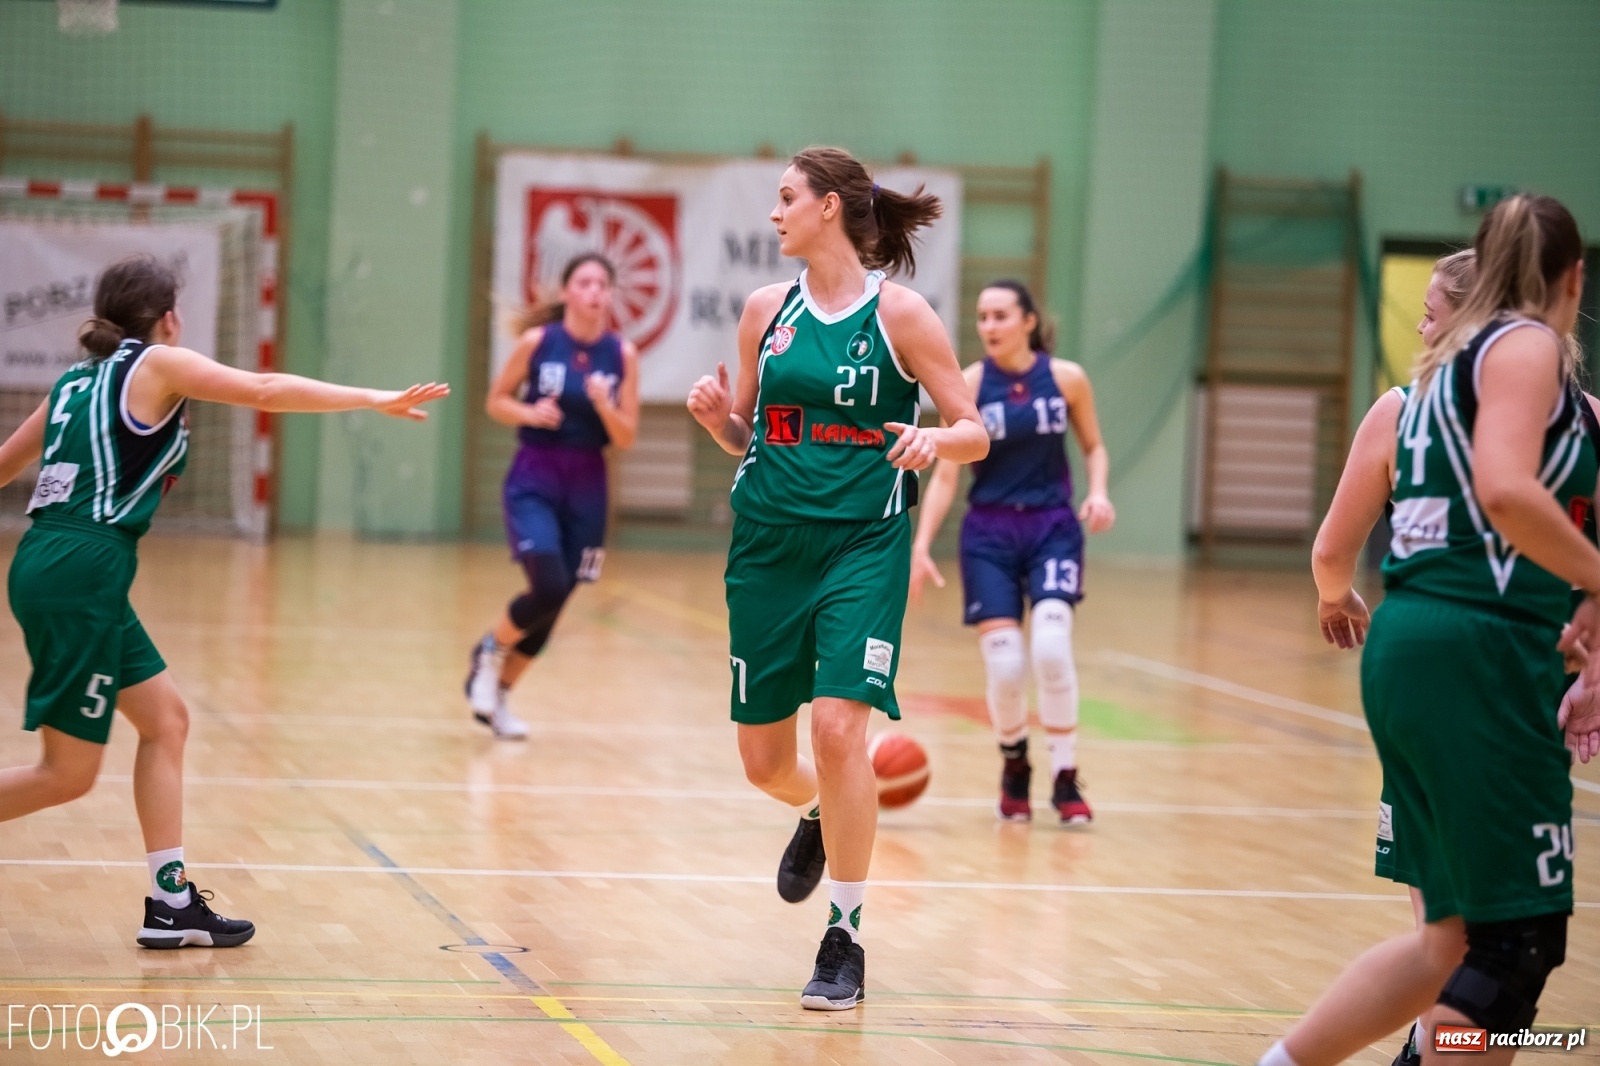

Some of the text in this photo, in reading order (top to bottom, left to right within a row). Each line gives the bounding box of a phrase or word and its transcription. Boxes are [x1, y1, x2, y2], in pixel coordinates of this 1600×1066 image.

[834, 365, 880, 406] 27
[44, 376, 93, 460] 5
[1032, 396, 1067, 434] 13
[1397, 385, 1432, 486] 4
[1043, 558, 1079, 594] 13
[79, 673, 114, 719] 5
[730, 655, 747, 704] 7
